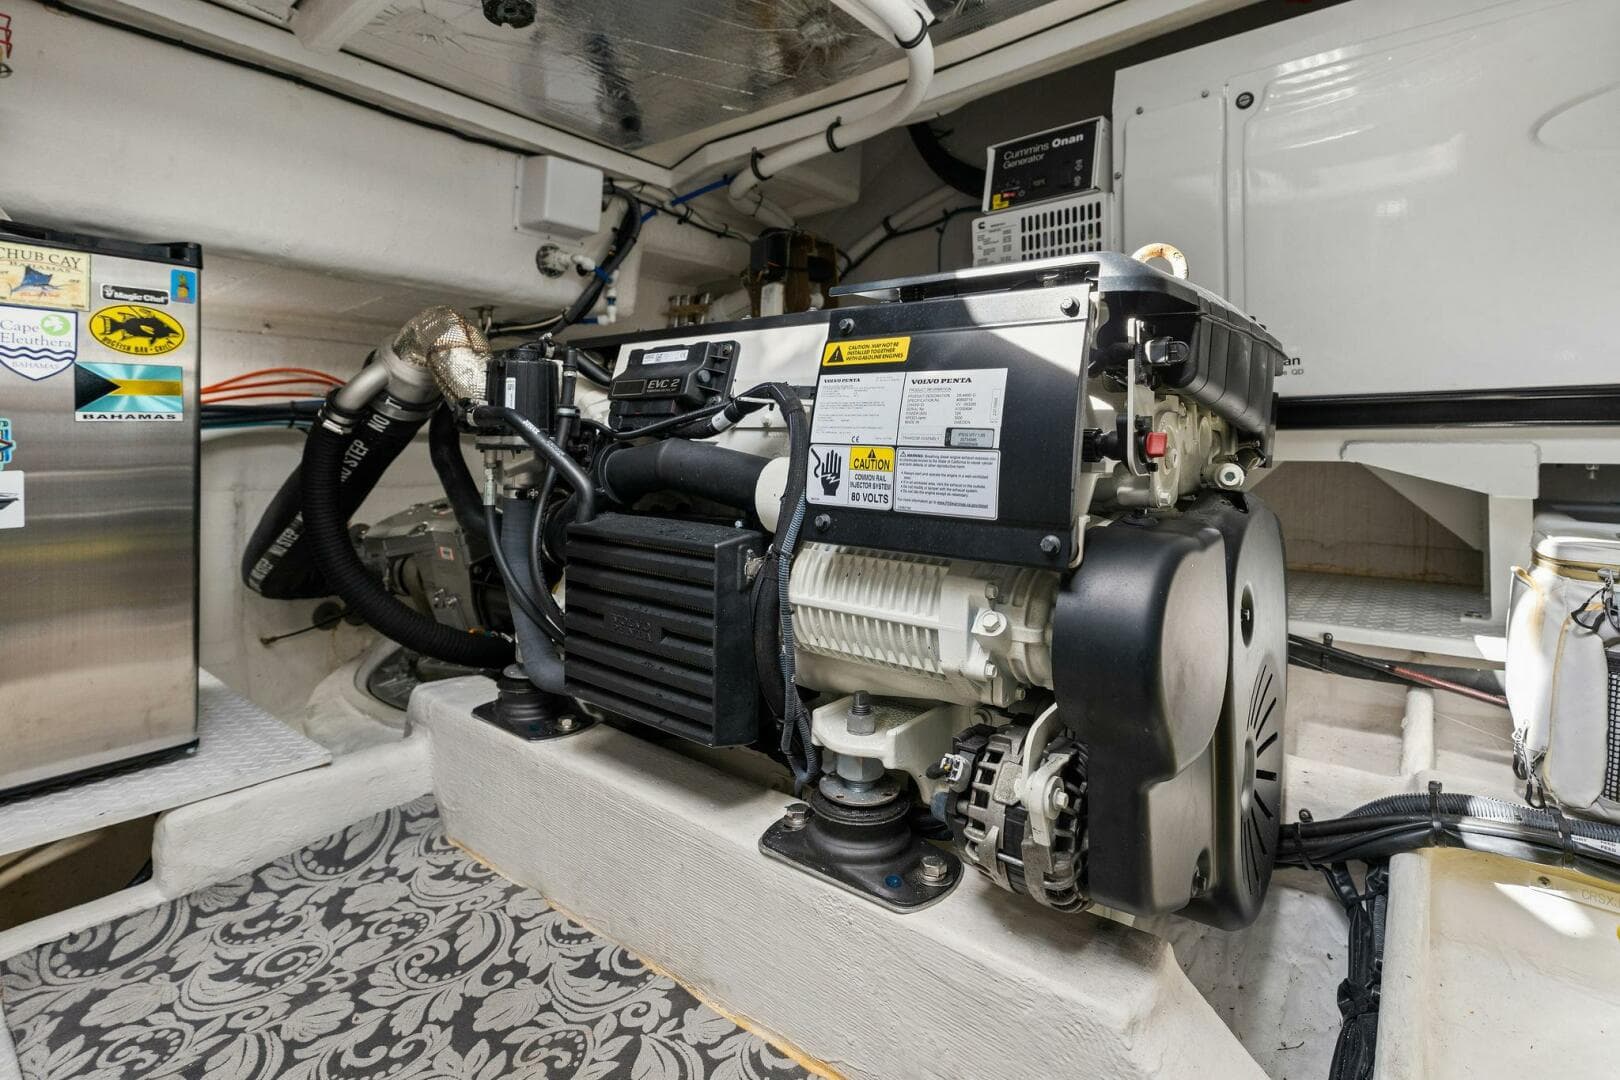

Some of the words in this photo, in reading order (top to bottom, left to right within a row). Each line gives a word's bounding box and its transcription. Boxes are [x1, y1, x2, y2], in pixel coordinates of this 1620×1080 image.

[1004, 142, 1050, 160] Cummins
[1052, 134, 1084, 148] Onan
[1002, 153, 1045, 170] Generator
[48, 254, 81, 269] CAY
[114, 292, 142, 301] Magic
[144, 294, 165, 303] Chef
[0, 320, 39, 334] Cape
[0, 332, 72, 347] Eleuthera
[648, 380, 669, 389] EVC
[670, 379, 680, 387] 2
[368, 414, 391, 433] NO
[344, 439, 369, 468] STEP
[854, 458, 890, 470] CAUTION
[851, 492, 860, 501] 80
[863, 493, 889, 504] VOLTS
